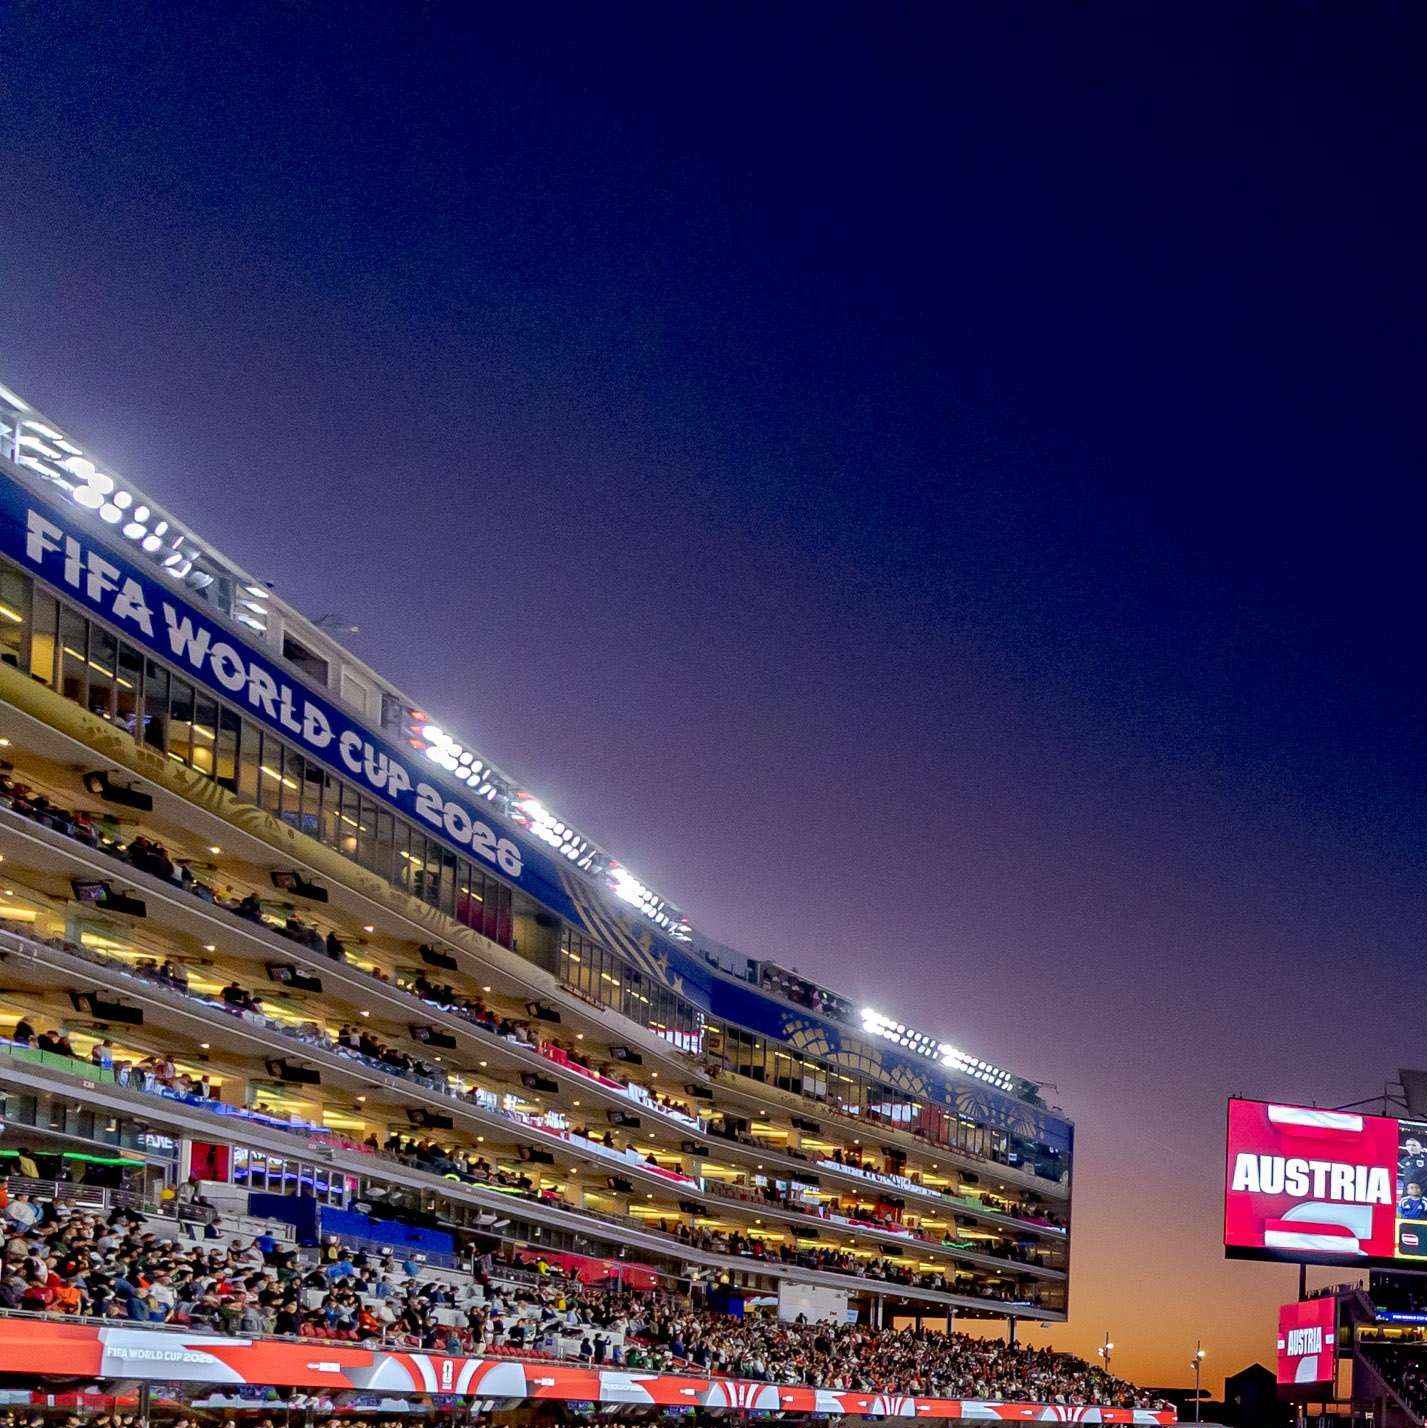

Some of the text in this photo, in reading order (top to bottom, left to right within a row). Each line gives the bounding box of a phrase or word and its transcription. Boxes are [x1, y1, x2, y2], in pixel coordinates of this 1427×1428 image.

[26, 508, 524, 880] FIFA WORLD CUP 2026
[1231, 1153, 1392, 1205] AUSTRIA
[107, 1346, 128, 1358] FIFA
[129, 1349, 163, 1361] WORLD
[164, 1351, 182, 1362] CUP
[1287, 1326, 1322, 1356] AUSTRIA
